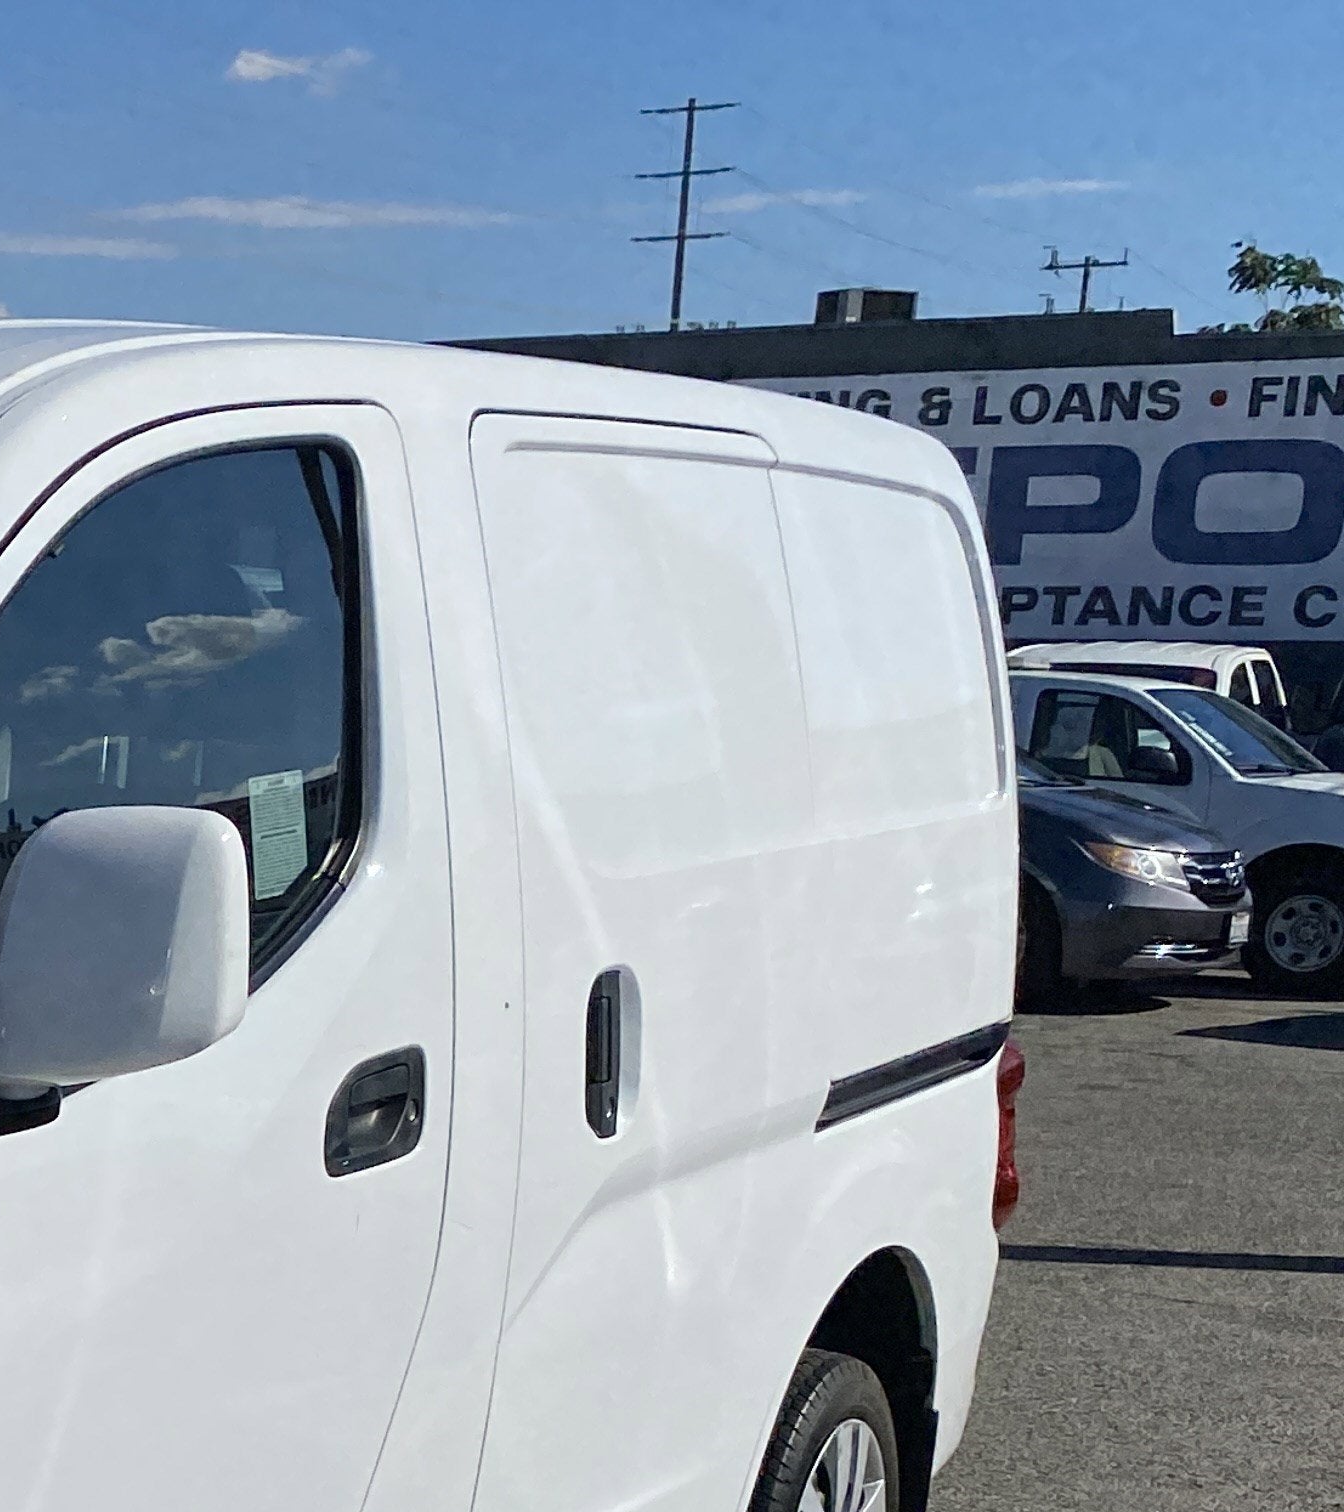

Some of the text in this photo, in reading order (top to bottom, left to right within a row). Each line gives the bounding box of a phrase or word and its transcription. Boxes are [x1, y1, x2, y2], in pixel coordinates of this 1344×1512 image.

[917, 386, 953, 426] &
[972, 379, 1181, 426] LOANS
[1247, 374, 1344, 418] FIN
[948, 440, 1344, 566] PO
